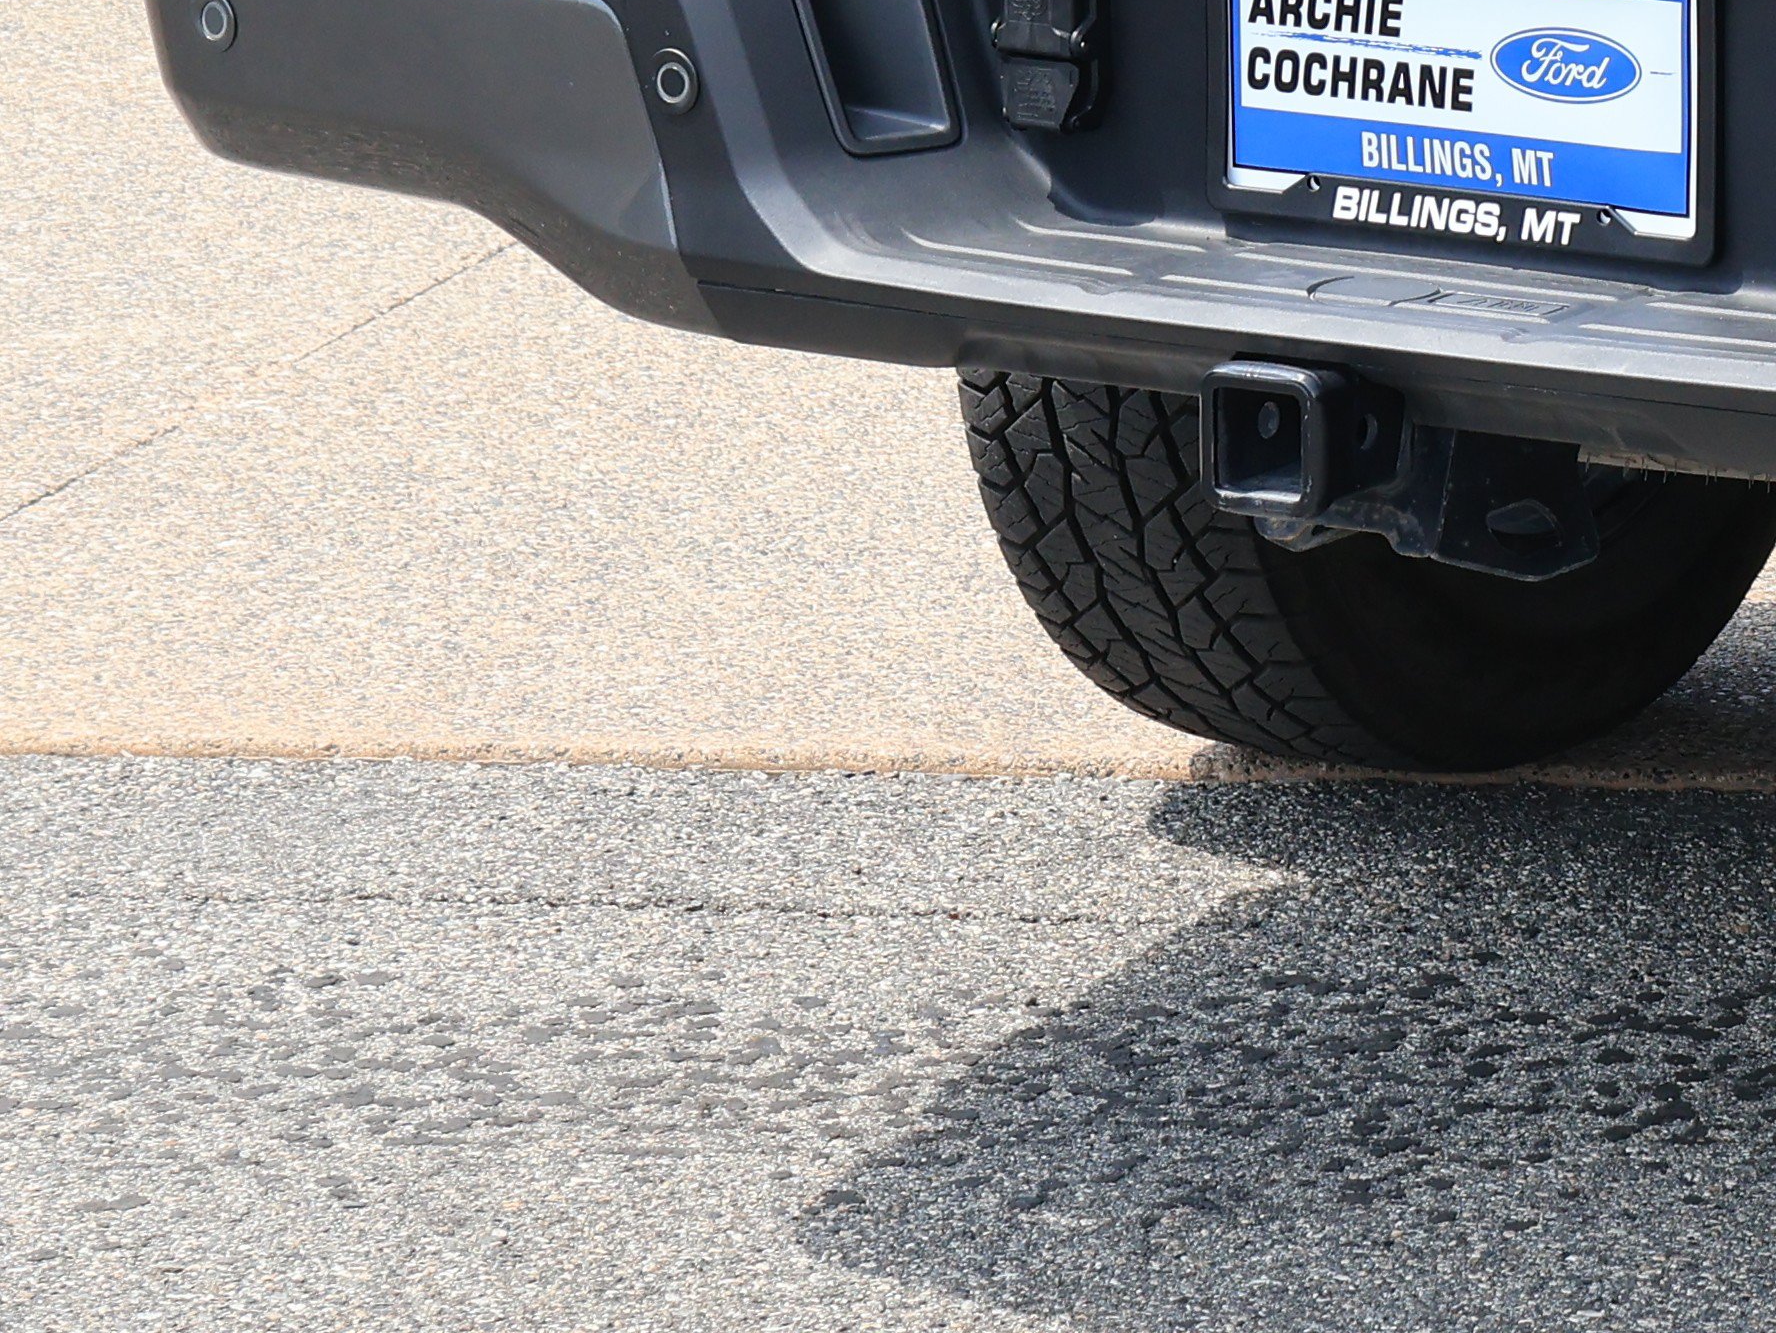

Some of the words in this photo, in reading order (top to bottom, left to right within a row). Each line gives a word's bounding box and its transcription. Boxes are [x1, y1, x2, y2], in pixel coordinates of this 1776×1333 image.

[1247, 46, 1475, 113] COCHRANE
[1520, 37, 1608, 90] Ford
[1361, 131, 1504, 187] BILLINGS,
[1511, 149, 1554, 188] MT
[1332, 185, 1508, 244] BILLINGS,
[1520, 208, 1582, 247] MT
